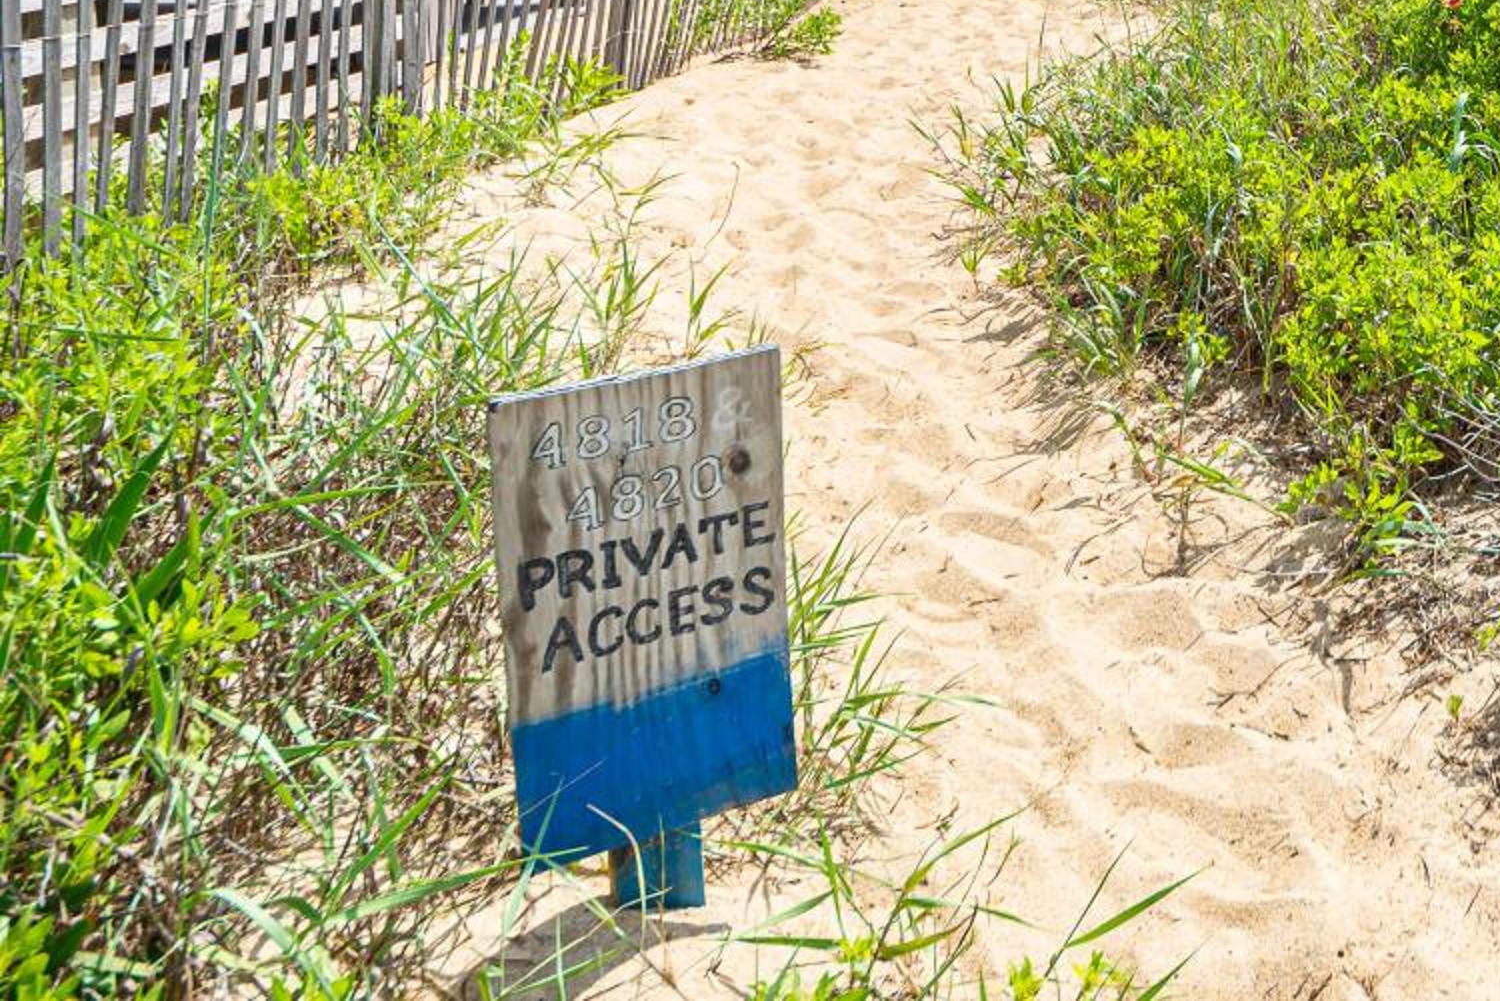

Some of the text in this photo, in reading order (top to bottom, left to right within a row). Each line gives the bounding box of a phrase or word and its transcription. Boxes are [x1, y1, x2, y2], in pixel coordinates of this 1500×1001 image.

[530, 386, 753, 470] 4818 &
[567, 454, 723, 531] 4820
[518, 501, 776, 611] PRIVATE
[541, 566, 776, 673] ACCESS
